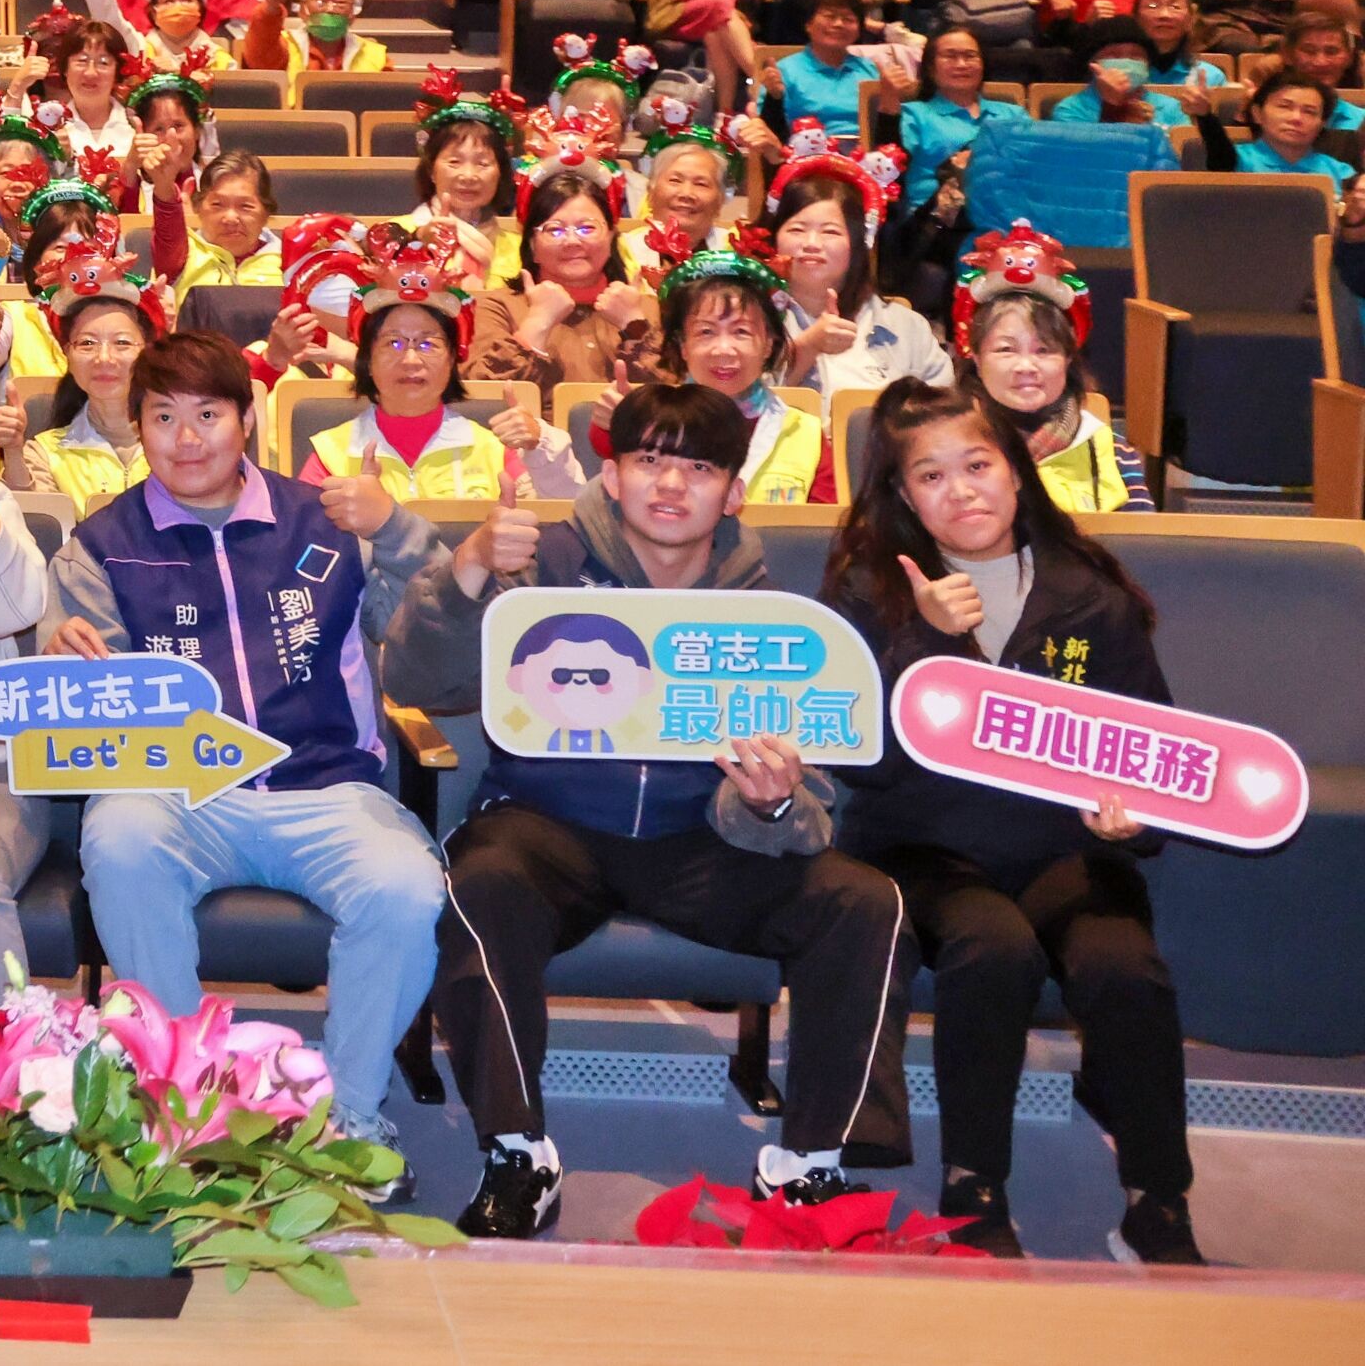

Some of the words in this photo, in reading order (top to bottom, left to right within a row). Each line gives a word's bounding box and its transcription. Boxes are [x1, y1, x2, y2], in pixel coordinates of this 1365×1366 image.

[277, 586, 321, 684] 劉美芳
[670, 630, 809, 674] 當志工
[657, 682, 864, 750] 最帥氣
[975, 694, 1218, 799] 用心服務
[191, 732, 246, 769] Go
